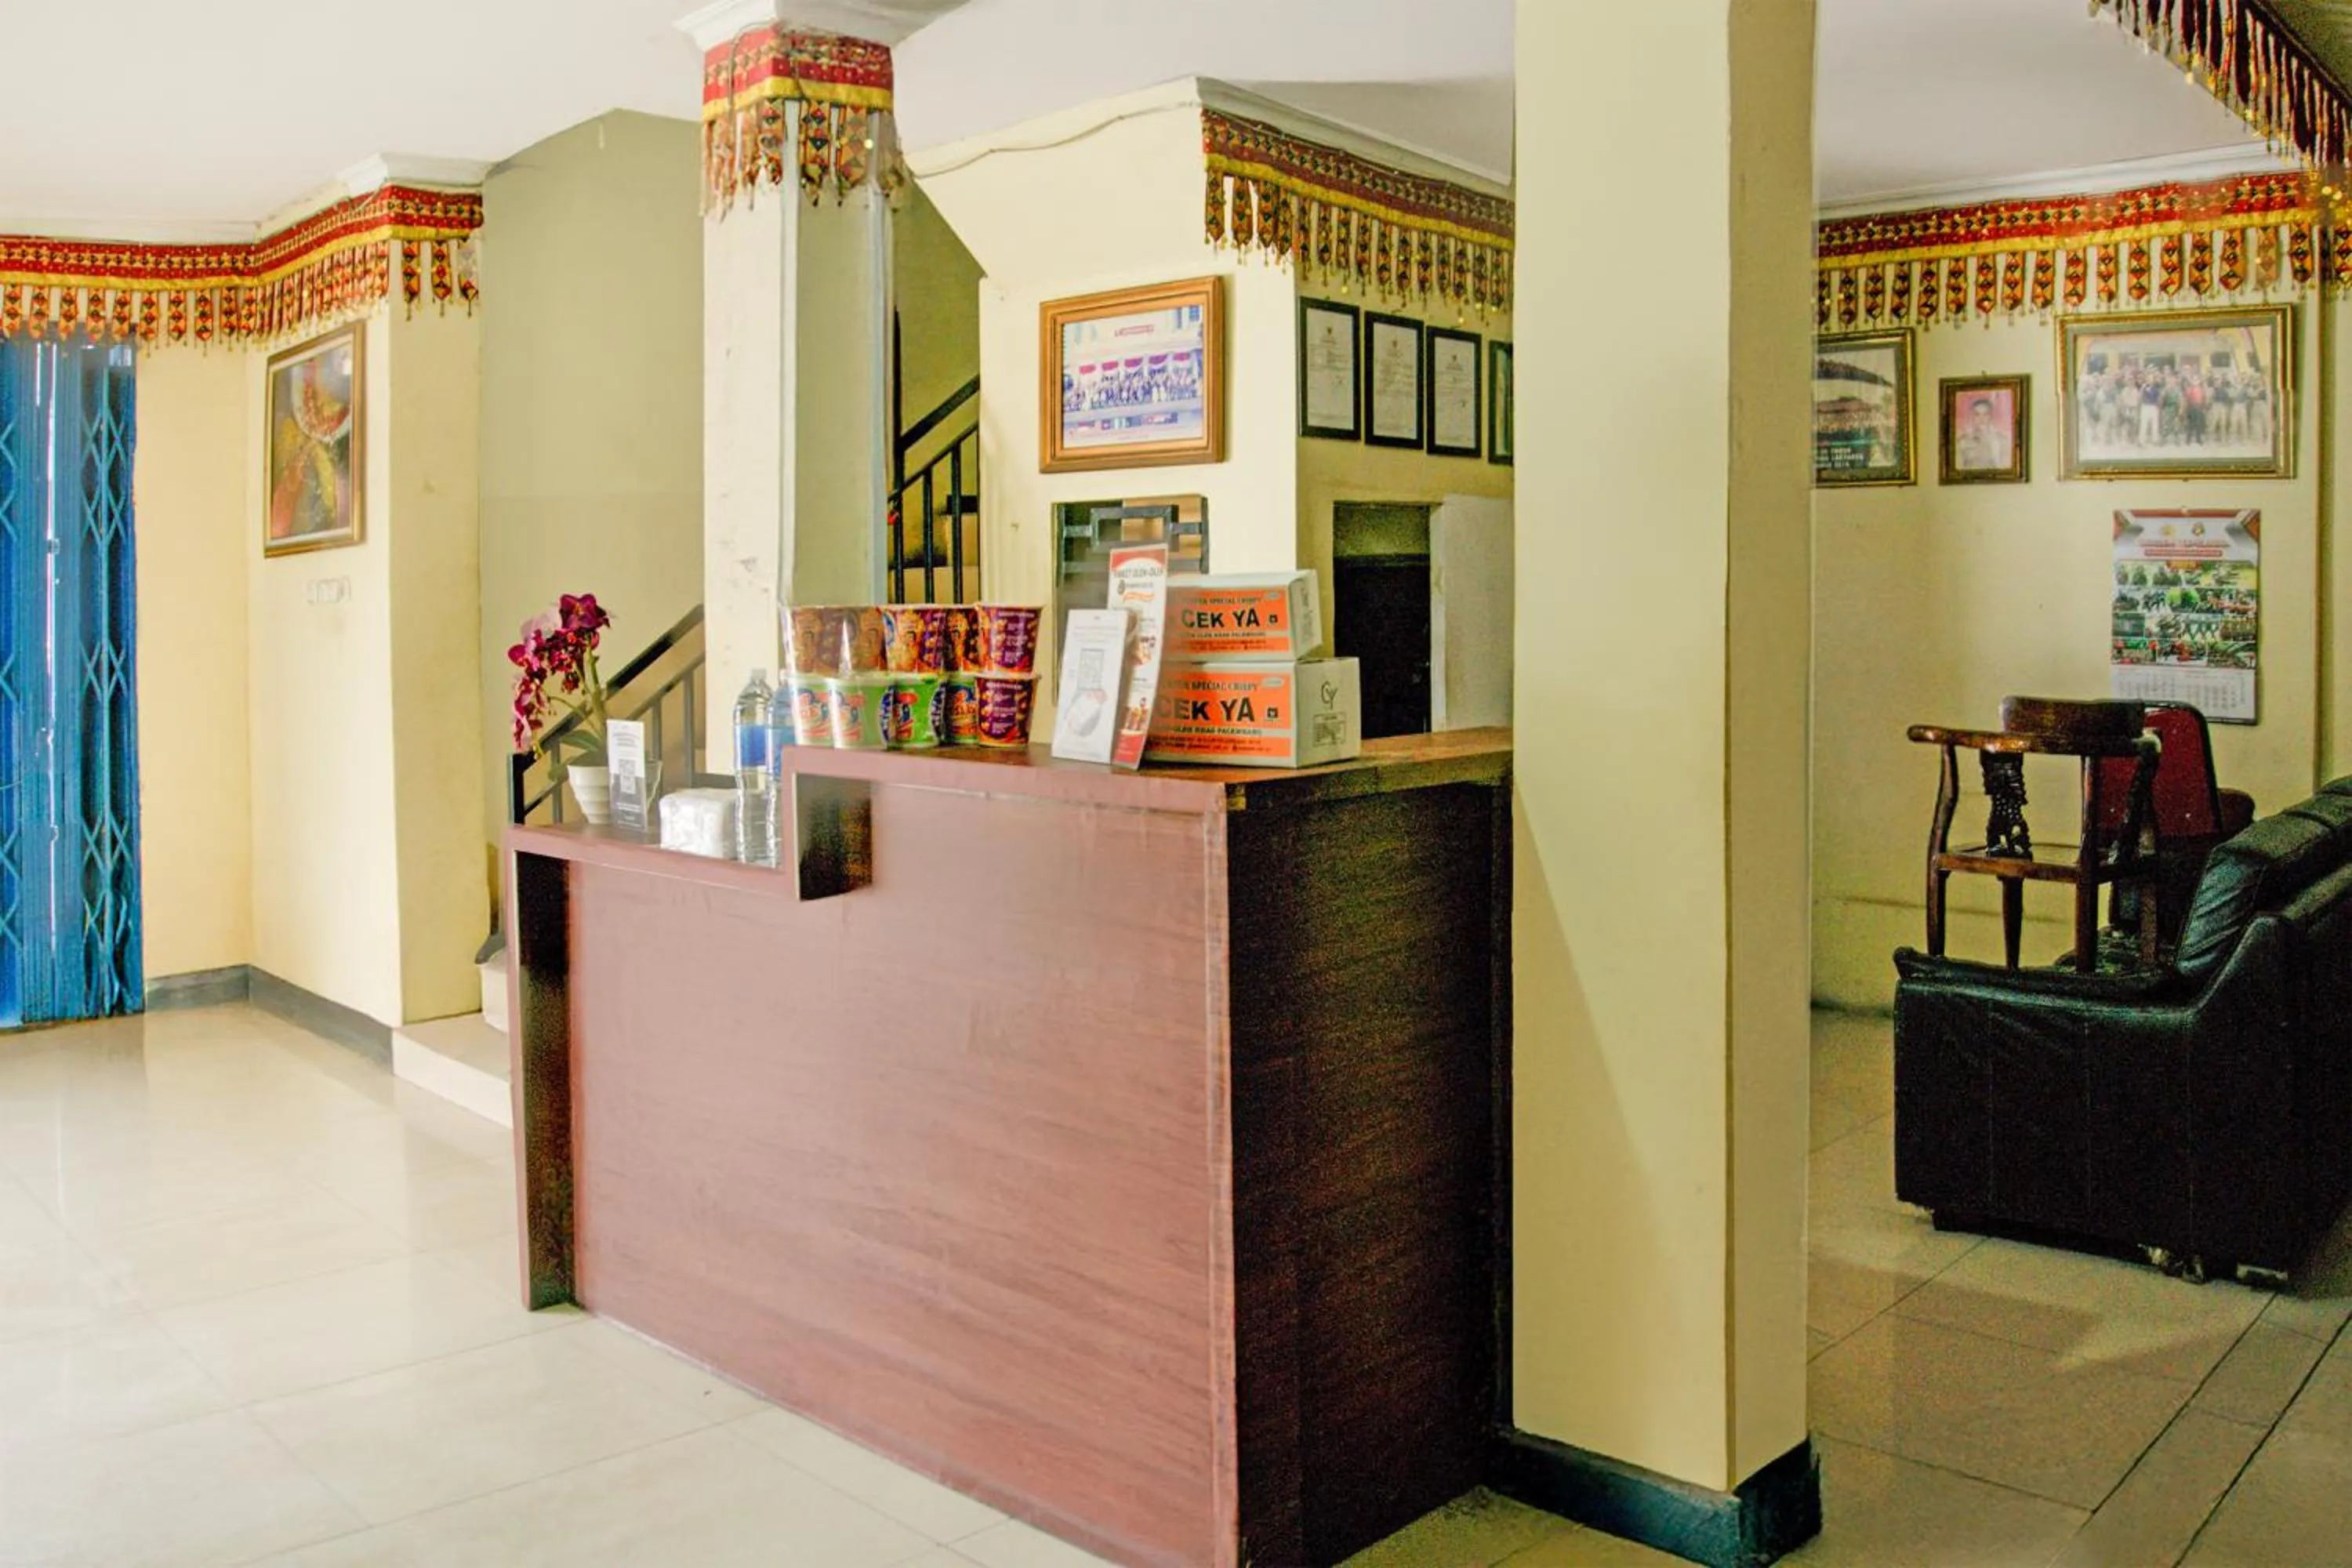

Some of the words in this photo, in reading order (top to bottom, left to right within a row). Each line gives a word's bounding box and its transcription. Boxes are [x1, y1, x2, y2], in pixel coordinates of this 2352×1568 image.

[1180, 608, 1225, 628] CEK
[1232, 607, 1260, 627] YA
[1220, 696, 1255, 722] YA
